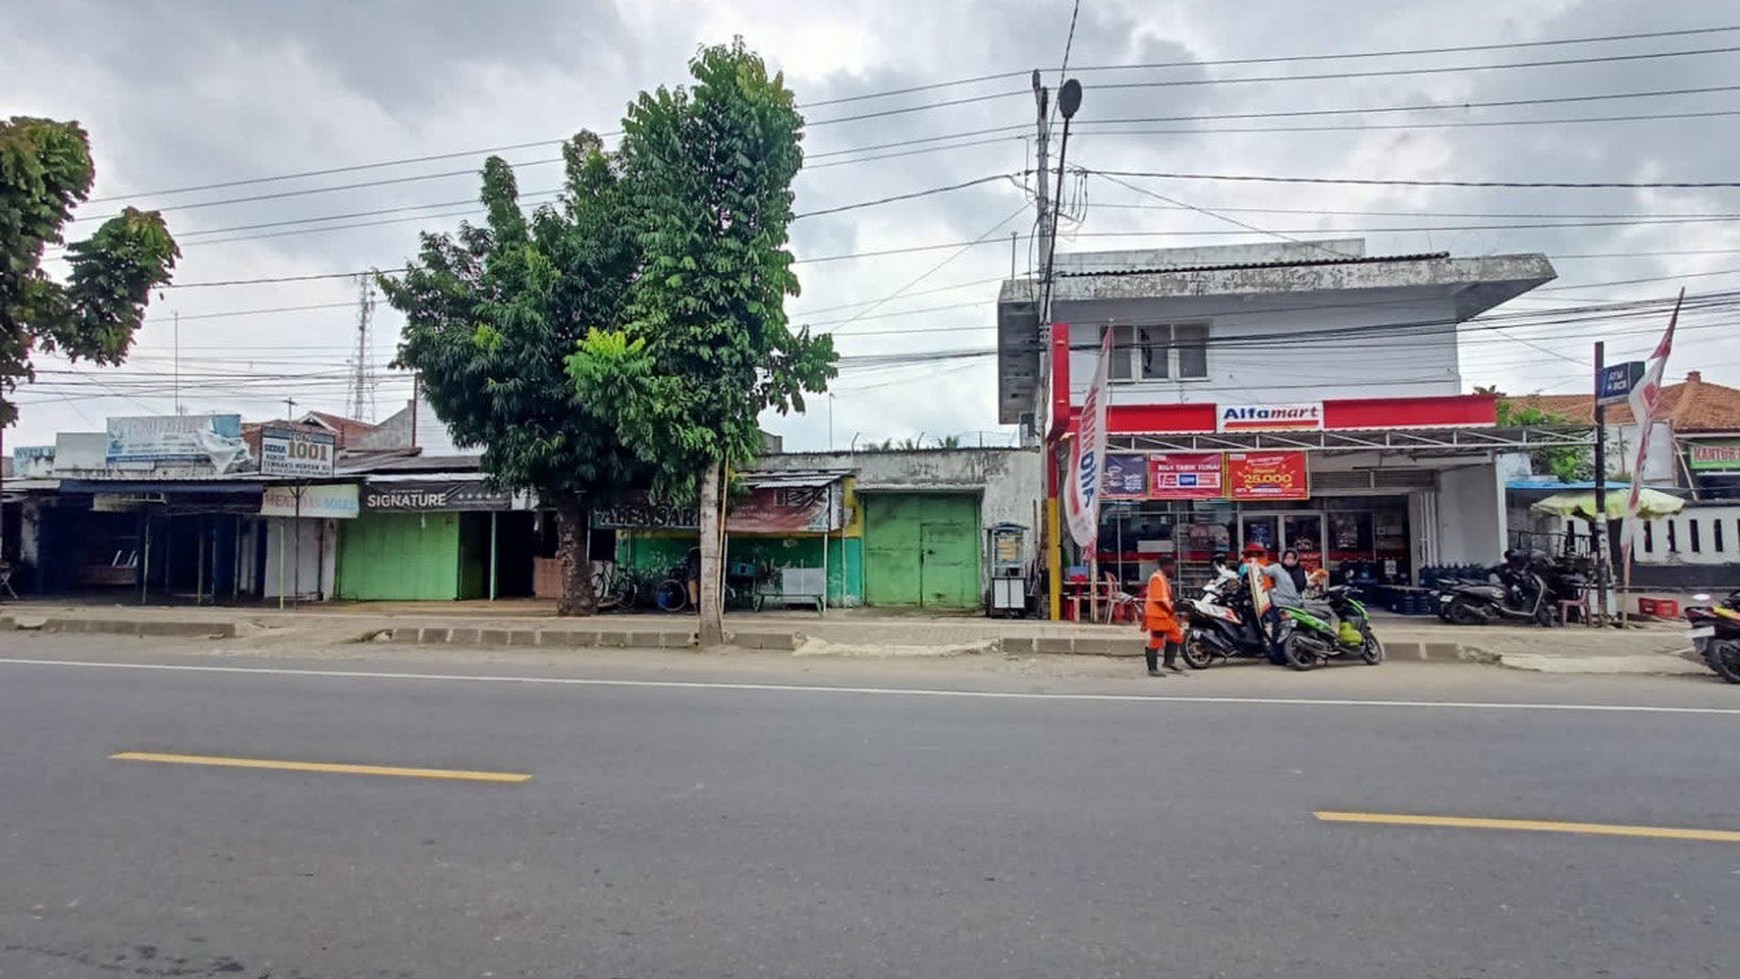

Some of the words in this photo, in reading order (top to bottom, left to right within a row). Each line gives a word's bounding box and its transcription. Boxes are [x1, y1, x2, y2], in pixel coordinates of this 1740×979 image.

[1608, 370, 1624, 380] ATM
[1224, 406, 1319, 419] Alfamart
[289, 442, 327, 461] 1001
[1243, 474, 1292, 484] 25.000
[367, 493, 447, 507] SIGNATURE
